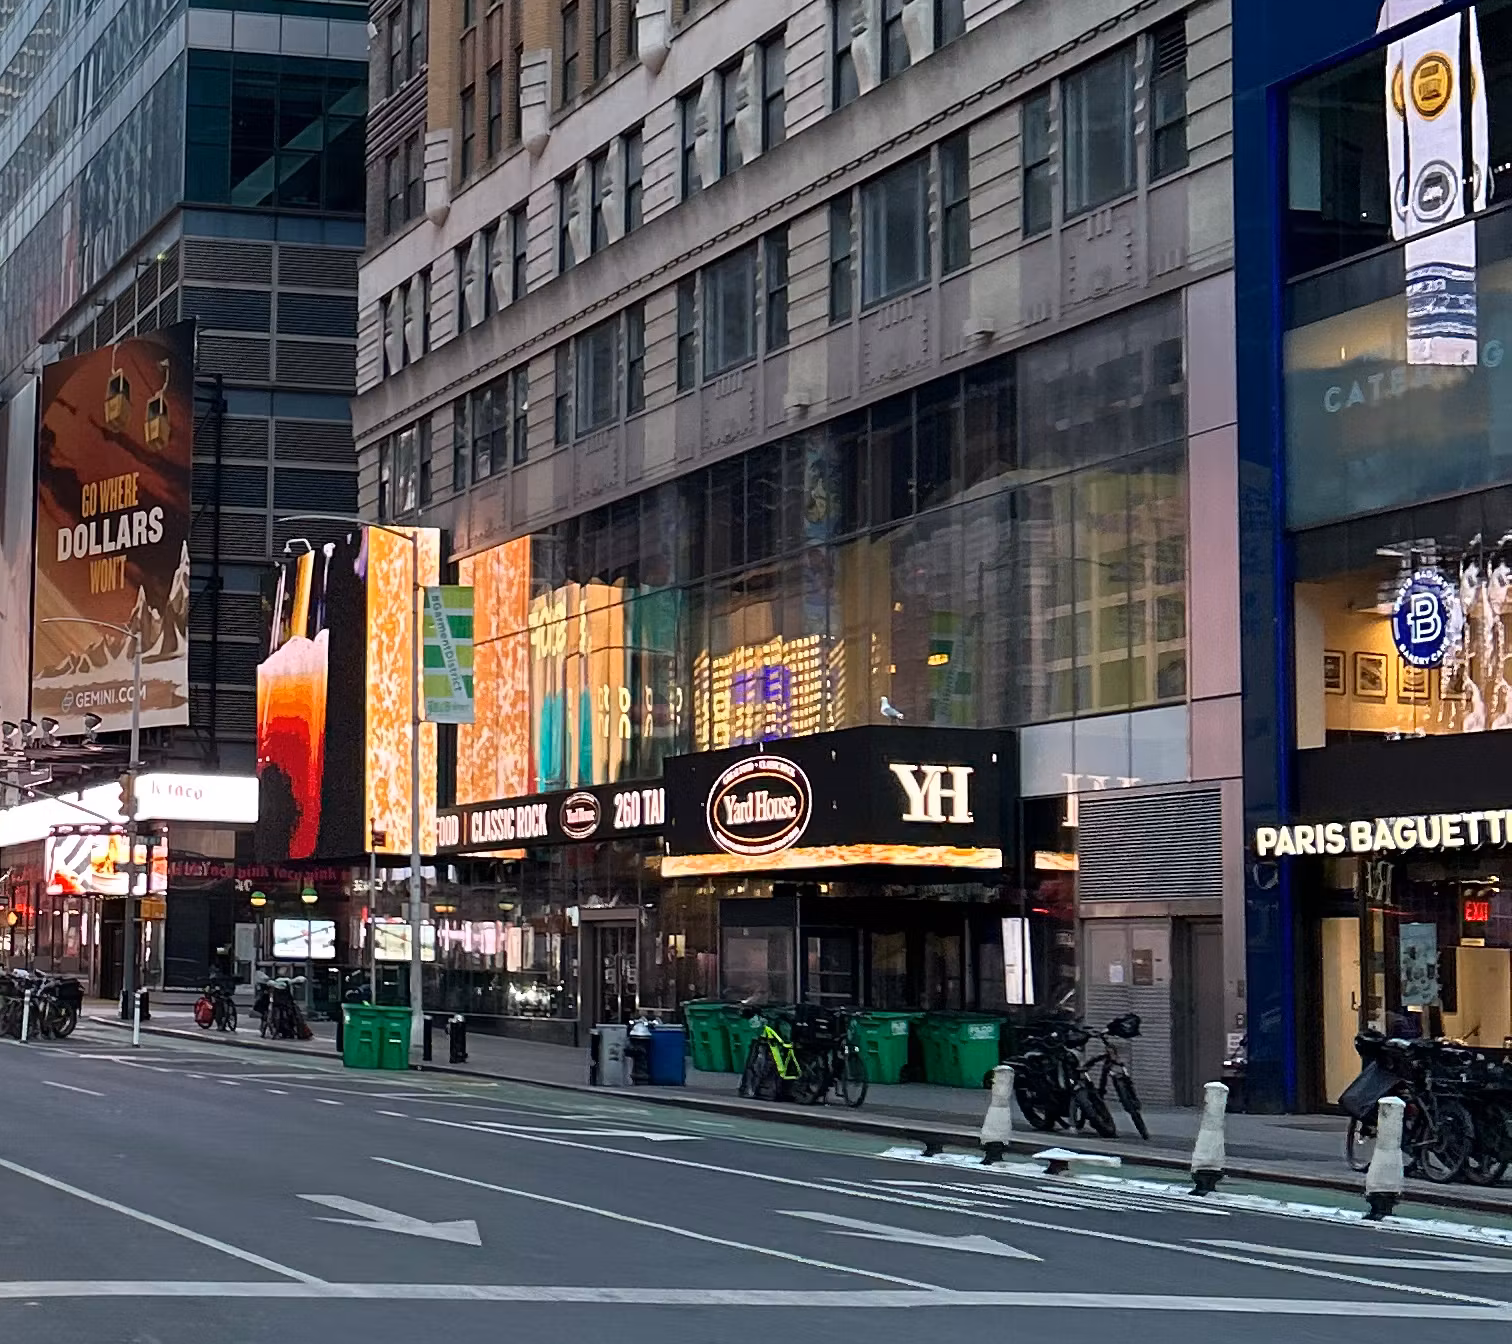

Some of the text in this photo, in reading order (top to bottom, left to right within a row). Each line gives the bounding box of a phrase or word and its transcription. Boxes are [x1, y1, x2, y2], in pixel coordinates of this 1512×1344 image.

[81, 472, 139, 519] GO WHERE
[57, 506, 165, 562] DOLLARS
[89, 555, 127, 595] WON'T
[75, 684, 148, 708] GEMINI.COM
[614, 791, 640, 829] 260
[723, 790, 797, 825] Yard House
[888, 763, 974, 823] YH
[471, 806, 515, 844] CLASSIC
[516, 803, 548, 838] ROCK
[1256, 810, 1512, 856] PARIS BAGUETT
[1464, 900, 1489, 922] EXIT
